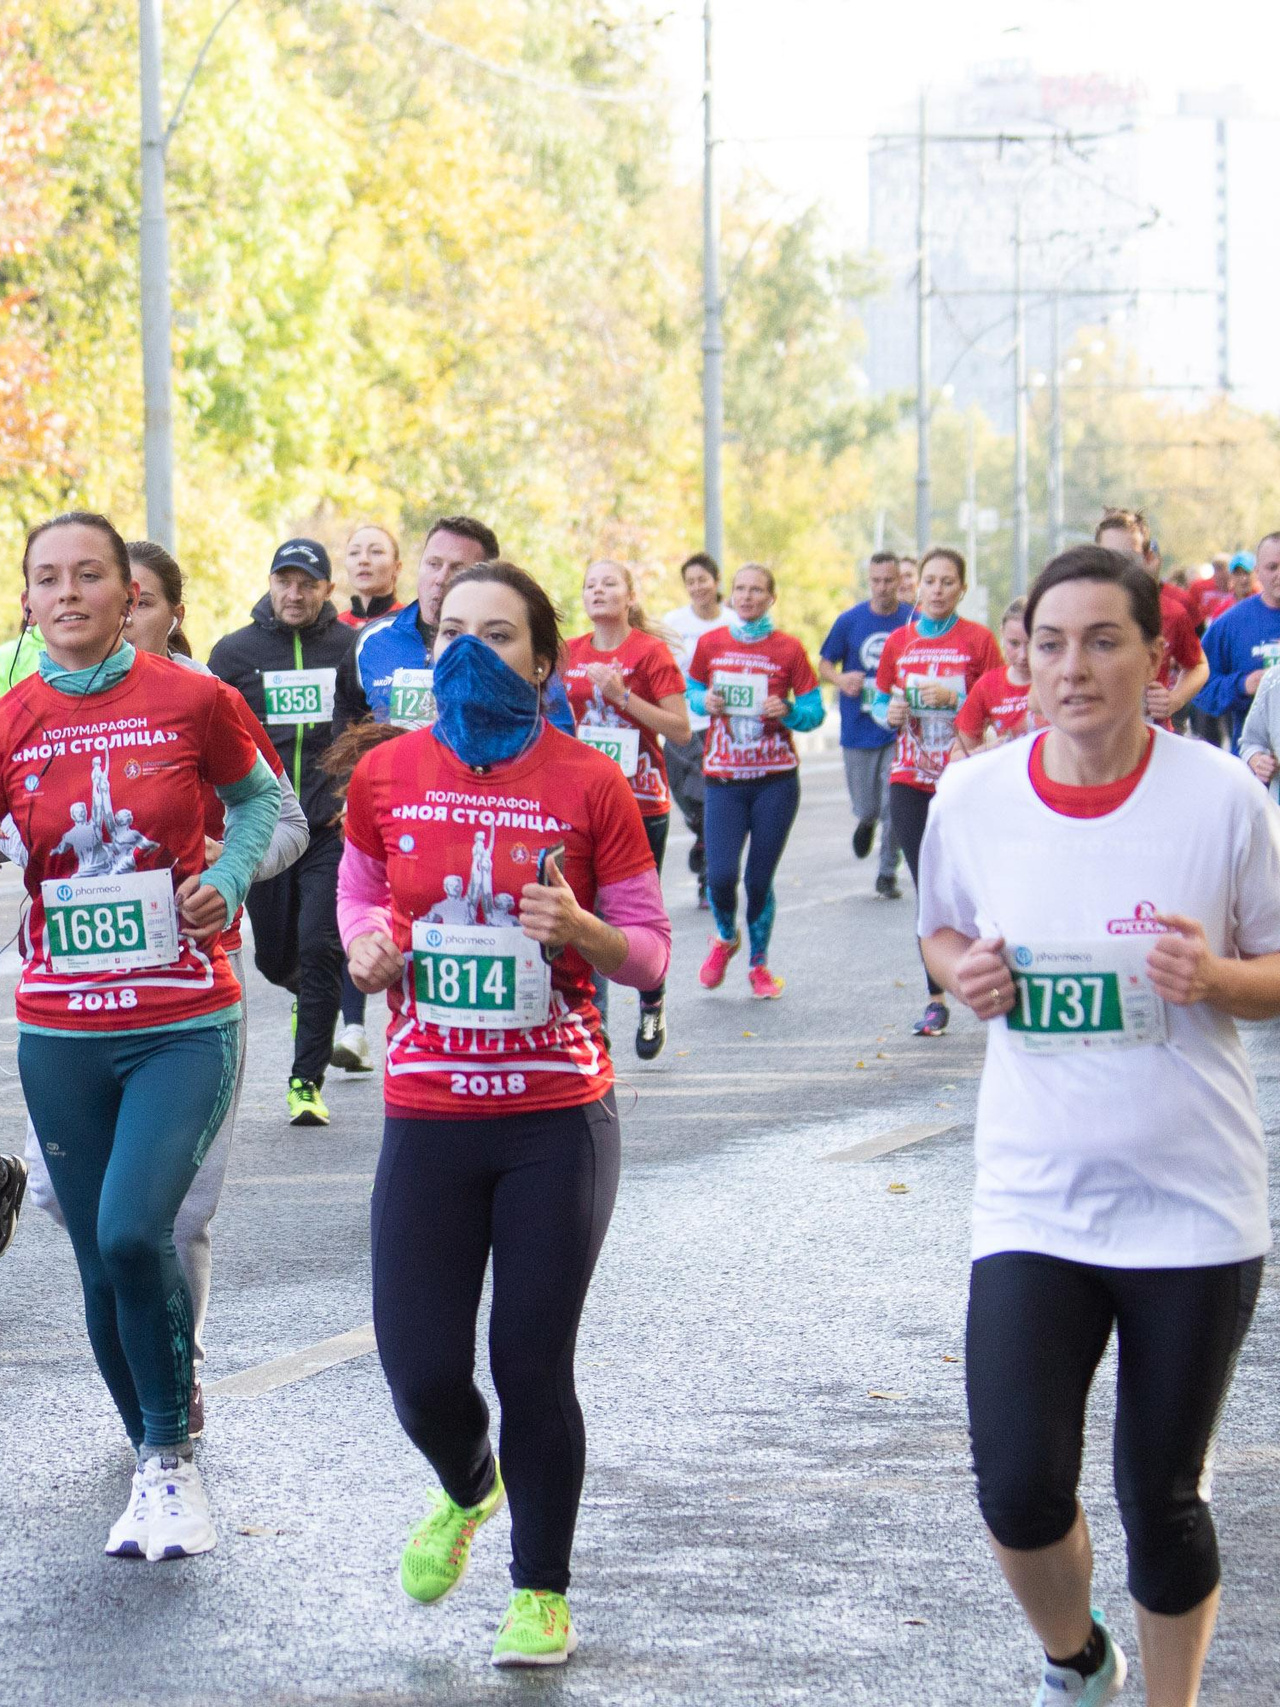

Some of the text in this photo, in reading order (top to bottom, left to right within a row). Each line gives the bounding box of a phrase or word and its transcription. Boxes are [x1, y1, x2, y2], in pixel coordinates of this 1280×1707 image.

[268, 687, 318, 712] 1358
[394, 689, 437, 716] 124
[42, 718, 148, 742] ПОЛУМАРАФОН
[12, 730, 179, 762] «МОЯ СТОЛИЦА»
[425, 790, 541, 812] ПОЛУМАРАФОН
[392, 805, 573, 834] «МОЯ СТОЛИЦА»
[75, 885, 121, 898] pharmeco
[51, 904, 139, 951] 1685
[445, 936, 496, 947] pharmeco
[1035, 952, 1092, 964] pharmeco
[421, 956, 507, 1005] 1814
[67, 988, 138, 1011] 2018
[1016, 977, 1104, 1028] 1737
[450, 1072, 527, 1097] 2018
